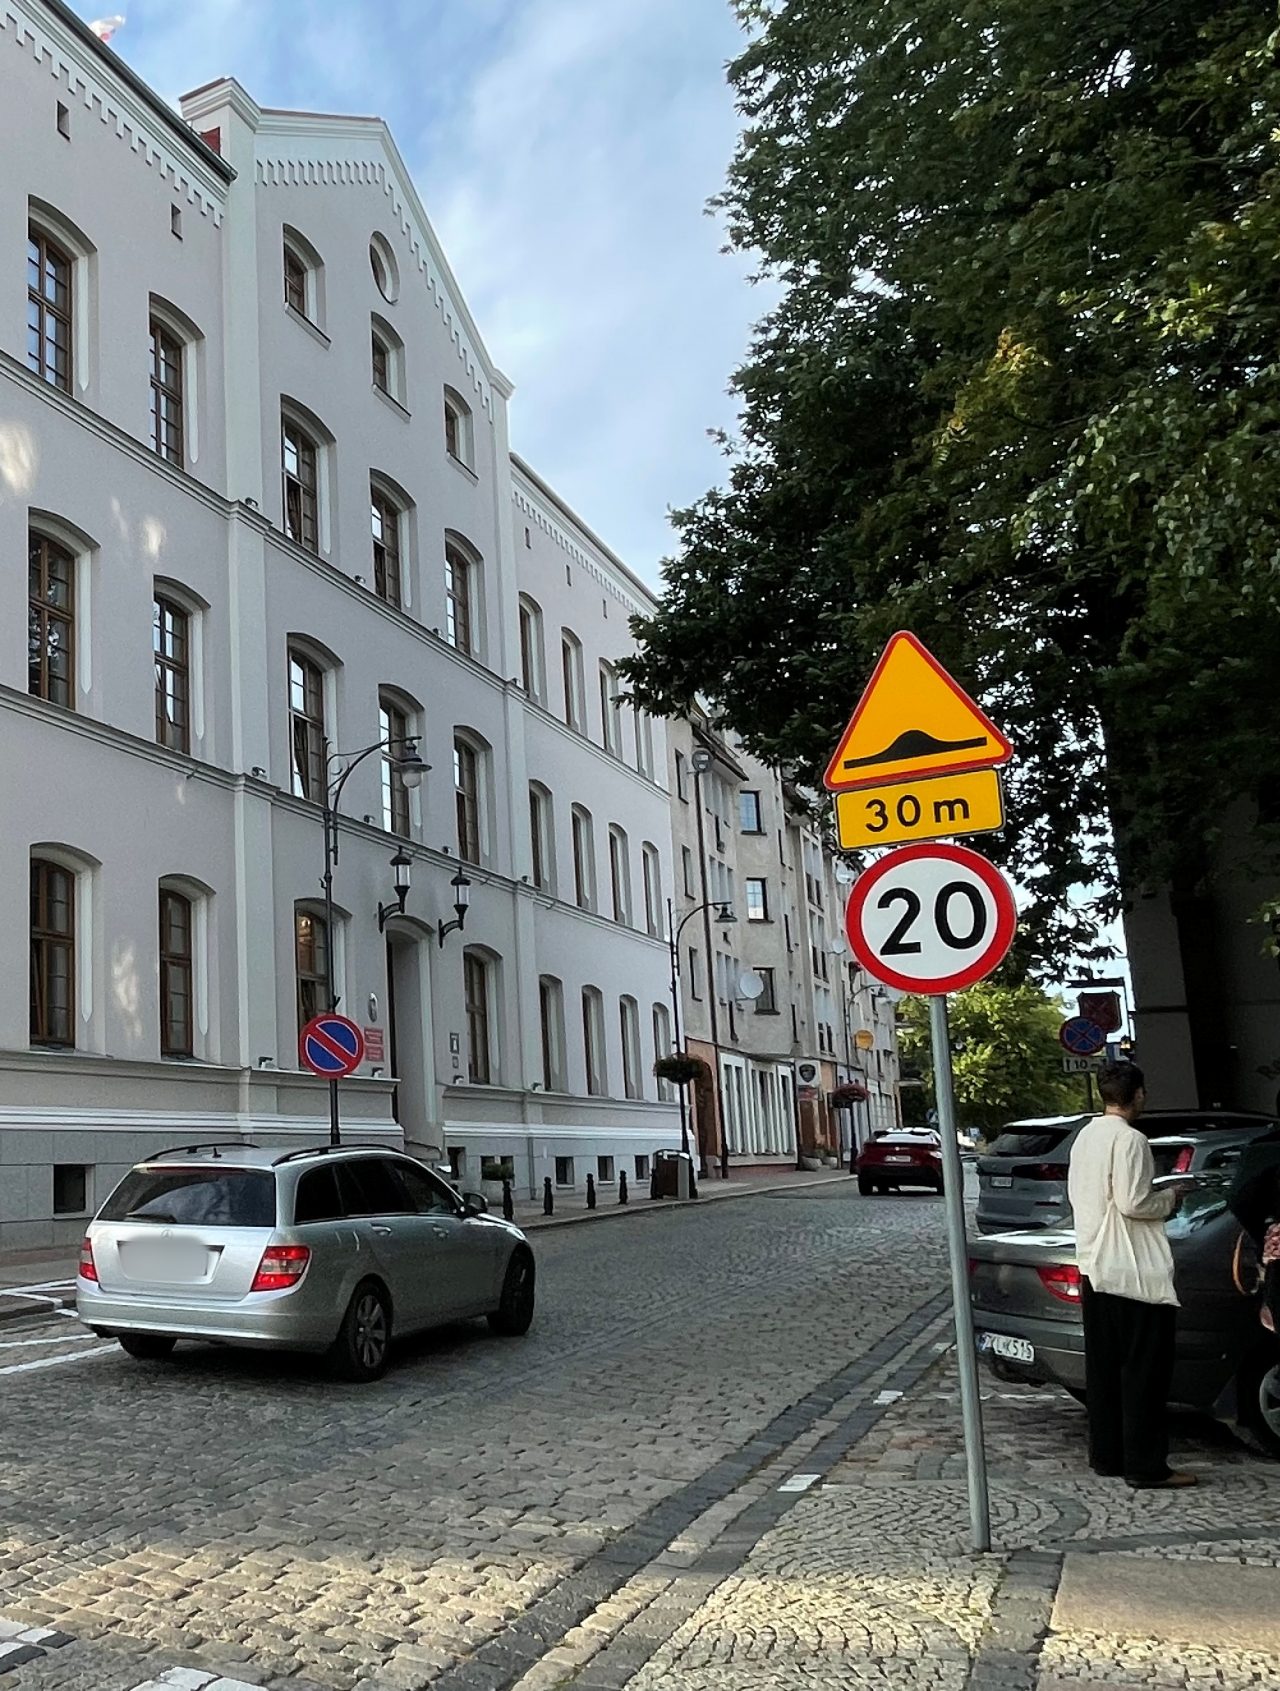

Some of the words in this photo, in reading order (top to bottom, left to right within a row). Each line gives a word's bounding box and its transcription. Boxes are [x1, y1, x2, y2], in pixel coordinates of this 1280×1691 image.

[864, 794, 922, 833] 30
[933, 797, 970, 823] m
[876, 880, 987, 956] 20
[1074, 1059, 1088, 1069] 10
